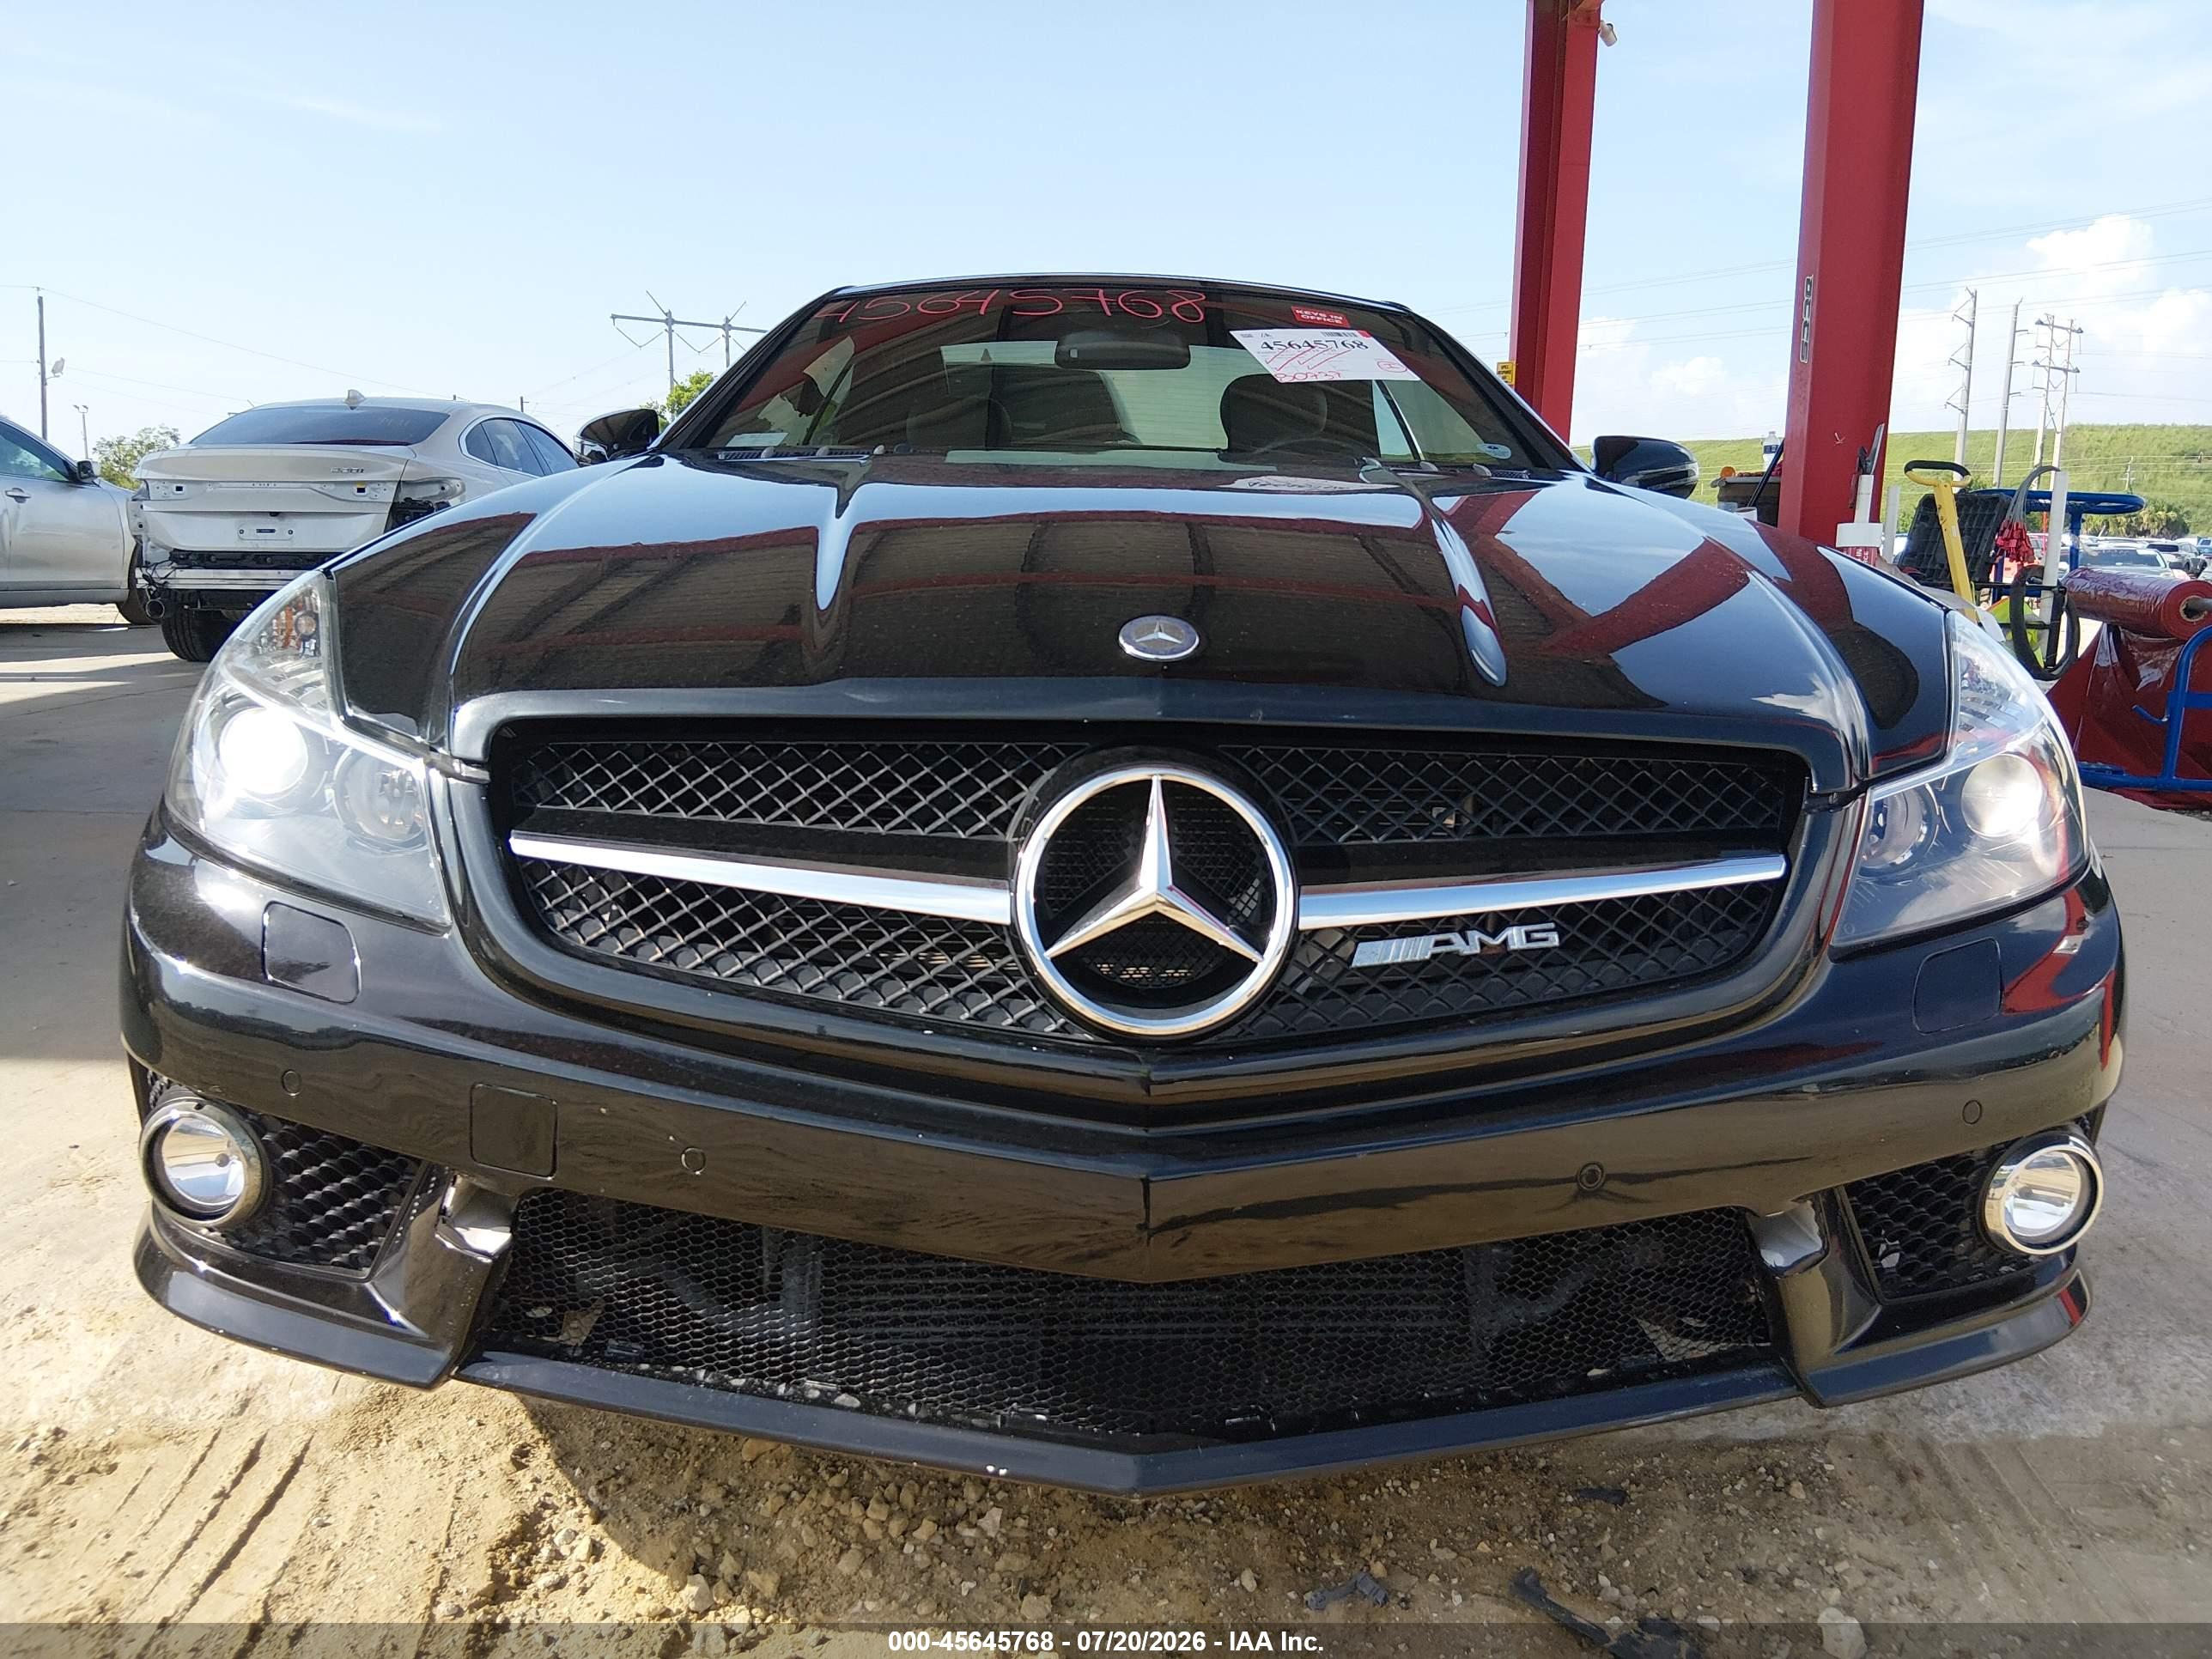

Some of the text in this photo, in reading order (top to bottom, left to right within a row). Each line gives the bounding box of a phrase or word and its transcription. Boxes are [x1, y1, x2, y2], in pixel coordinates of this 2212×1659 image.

[812, 288, 1206, 324] 45645768
[1300, 314, 1342, 324] OFFICE
[1261, 340, 1370, 349] 45645768
[1427, 922, 1560, 958] AMG
